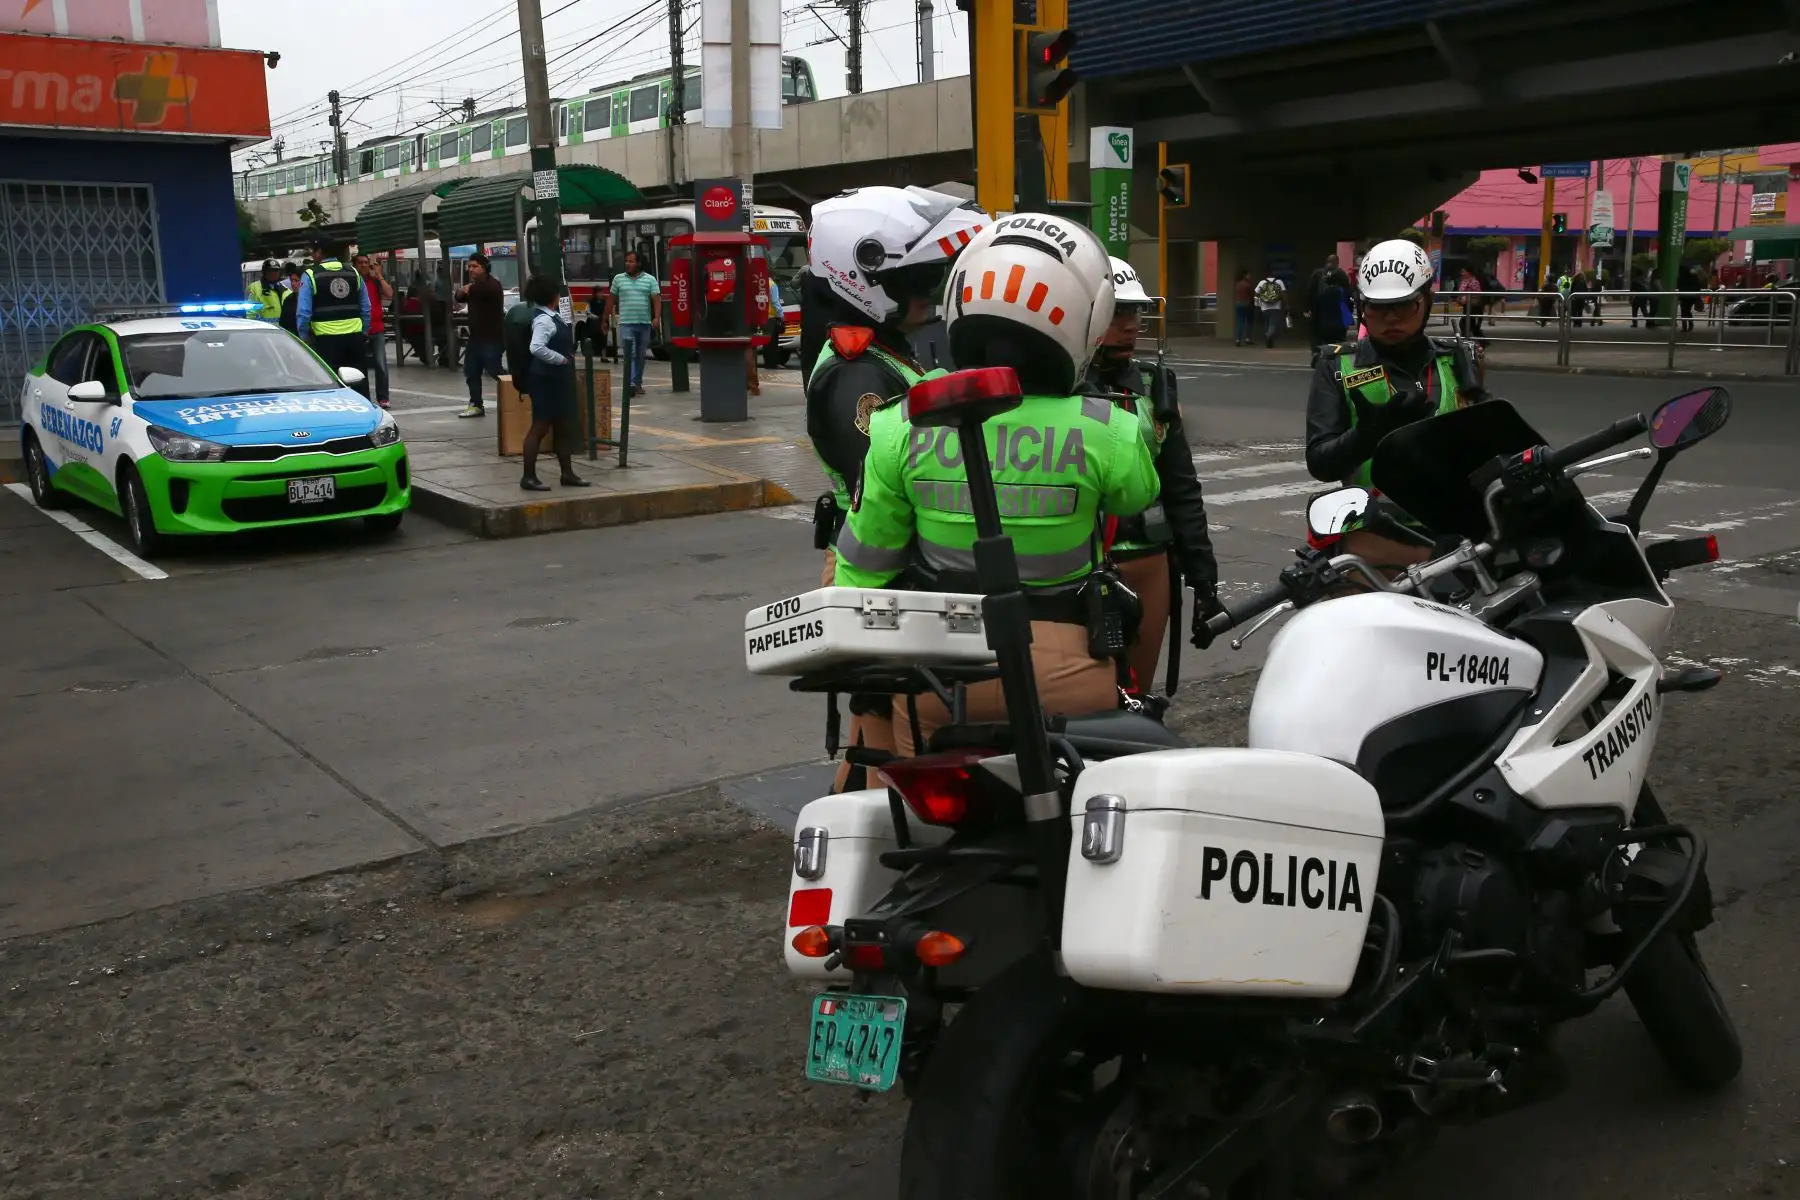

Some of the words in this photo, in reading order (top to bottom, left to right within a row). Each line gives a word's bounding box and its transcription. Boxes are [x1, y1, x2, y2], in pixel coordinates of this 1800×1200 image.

[0, 69, 102, 113] ma
[704, 199, 730, 208] Claro
[1119, 182, 1128, 218] Lima
[770, 220, 791, 230] LINCE
[1108, 196, 1118, 242] Metro
[1119, 223, 1128, 242] de
[995, 217, 1078, 258] POLICIA
[1113, 270, 1142, 286] OLI
[1364, 259, 1415, 288] POLICIA
[677, 279, 688, 312] Claro
[757, 278, 768, 311] Caro
[40, 402, 104, 456] SERENAZGO
[109, 416, 123, 440] 54
[182, 403, 370, 426] INTEGRADO
[908, 424, 1088, 475] POICIA
[289, 482, 334, 500] BLP-414
[914, 481, 1077, 517] TRASITO
[766, 597, 801, 622] FOTO
[749, 620, 824, 655] PAPELETAS
[1427, 652, 1510, 686] PL-18404
[1582, 692, 1653, 781] TRANSITO
[1200, 846, 1363, 913] POLICIA
[811, 1020, 896, 1070] EP-4747
